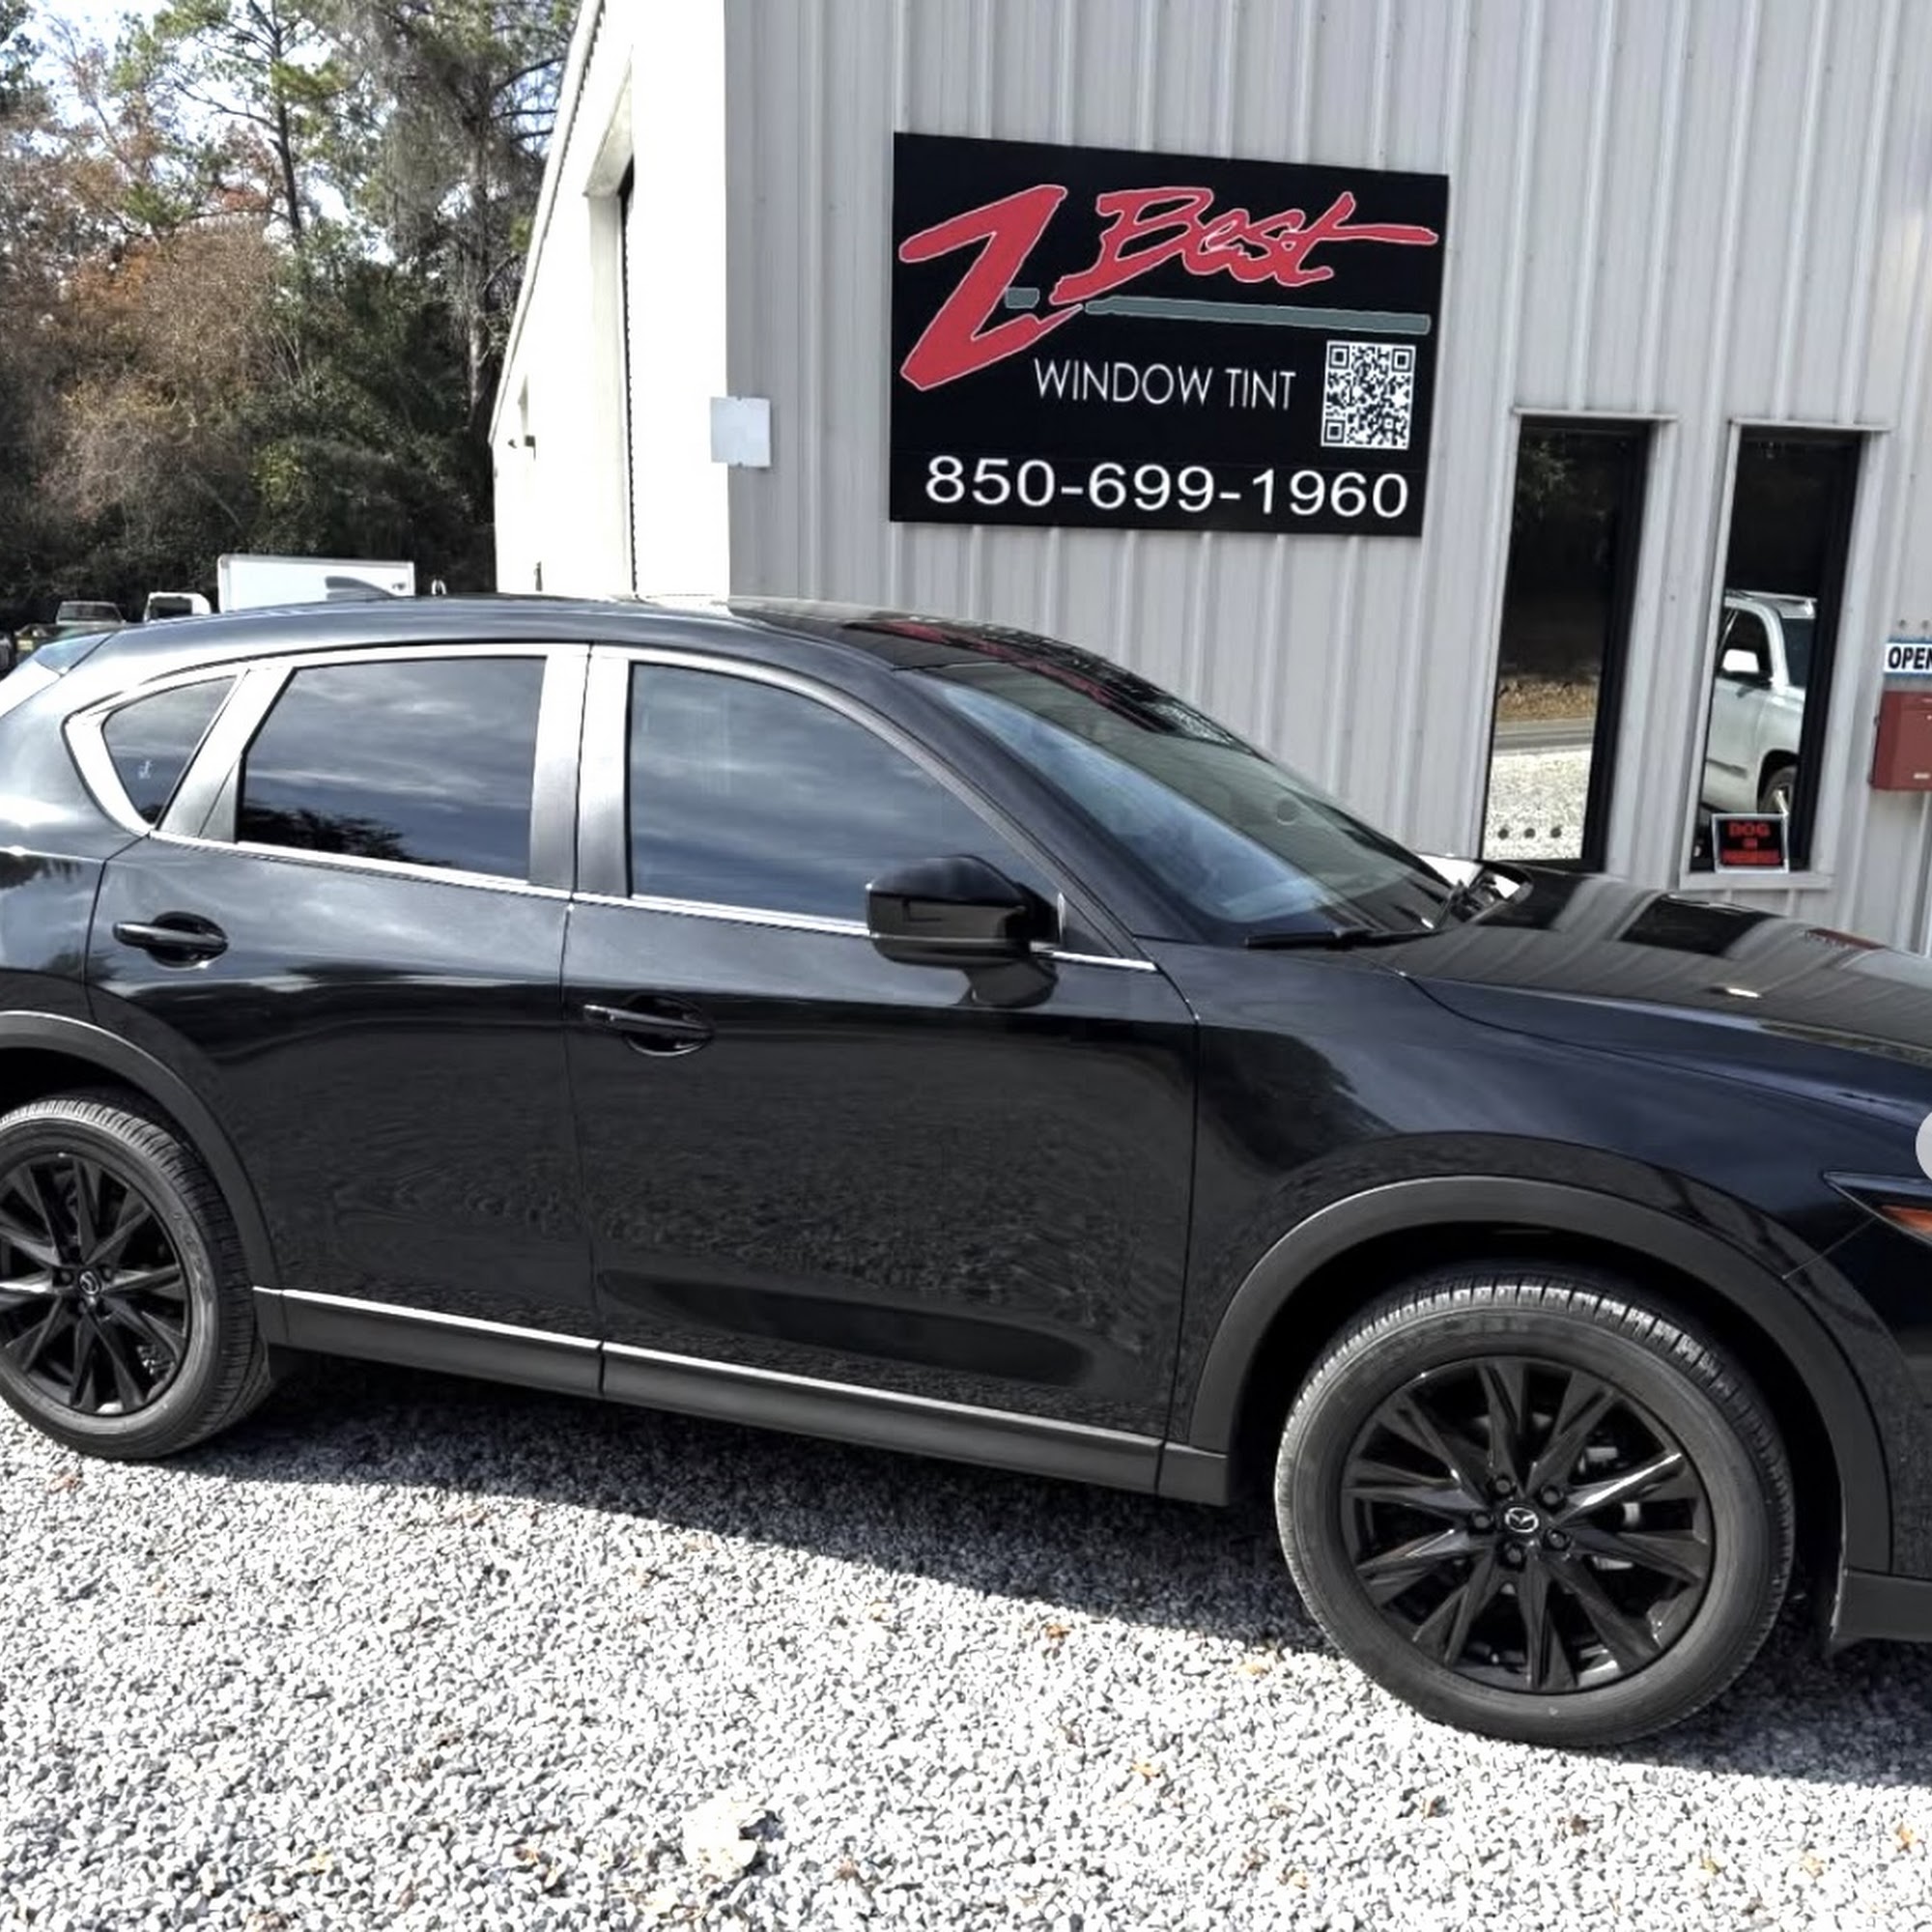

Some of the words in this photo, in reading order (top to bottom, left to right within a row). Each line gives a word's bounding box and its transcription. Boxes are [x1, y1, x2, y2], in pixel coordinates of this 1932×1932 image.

[899, 185, 1083, 391] Z
[1049, 186, 1438, 305] Best
[1034, 357, 1213, 406] WINDOW
[1225, 367, 1296, 411] TINT
[924, 455, 1409, 520] 850-699-1960
[1728, 822, 1771, 838] DOG
